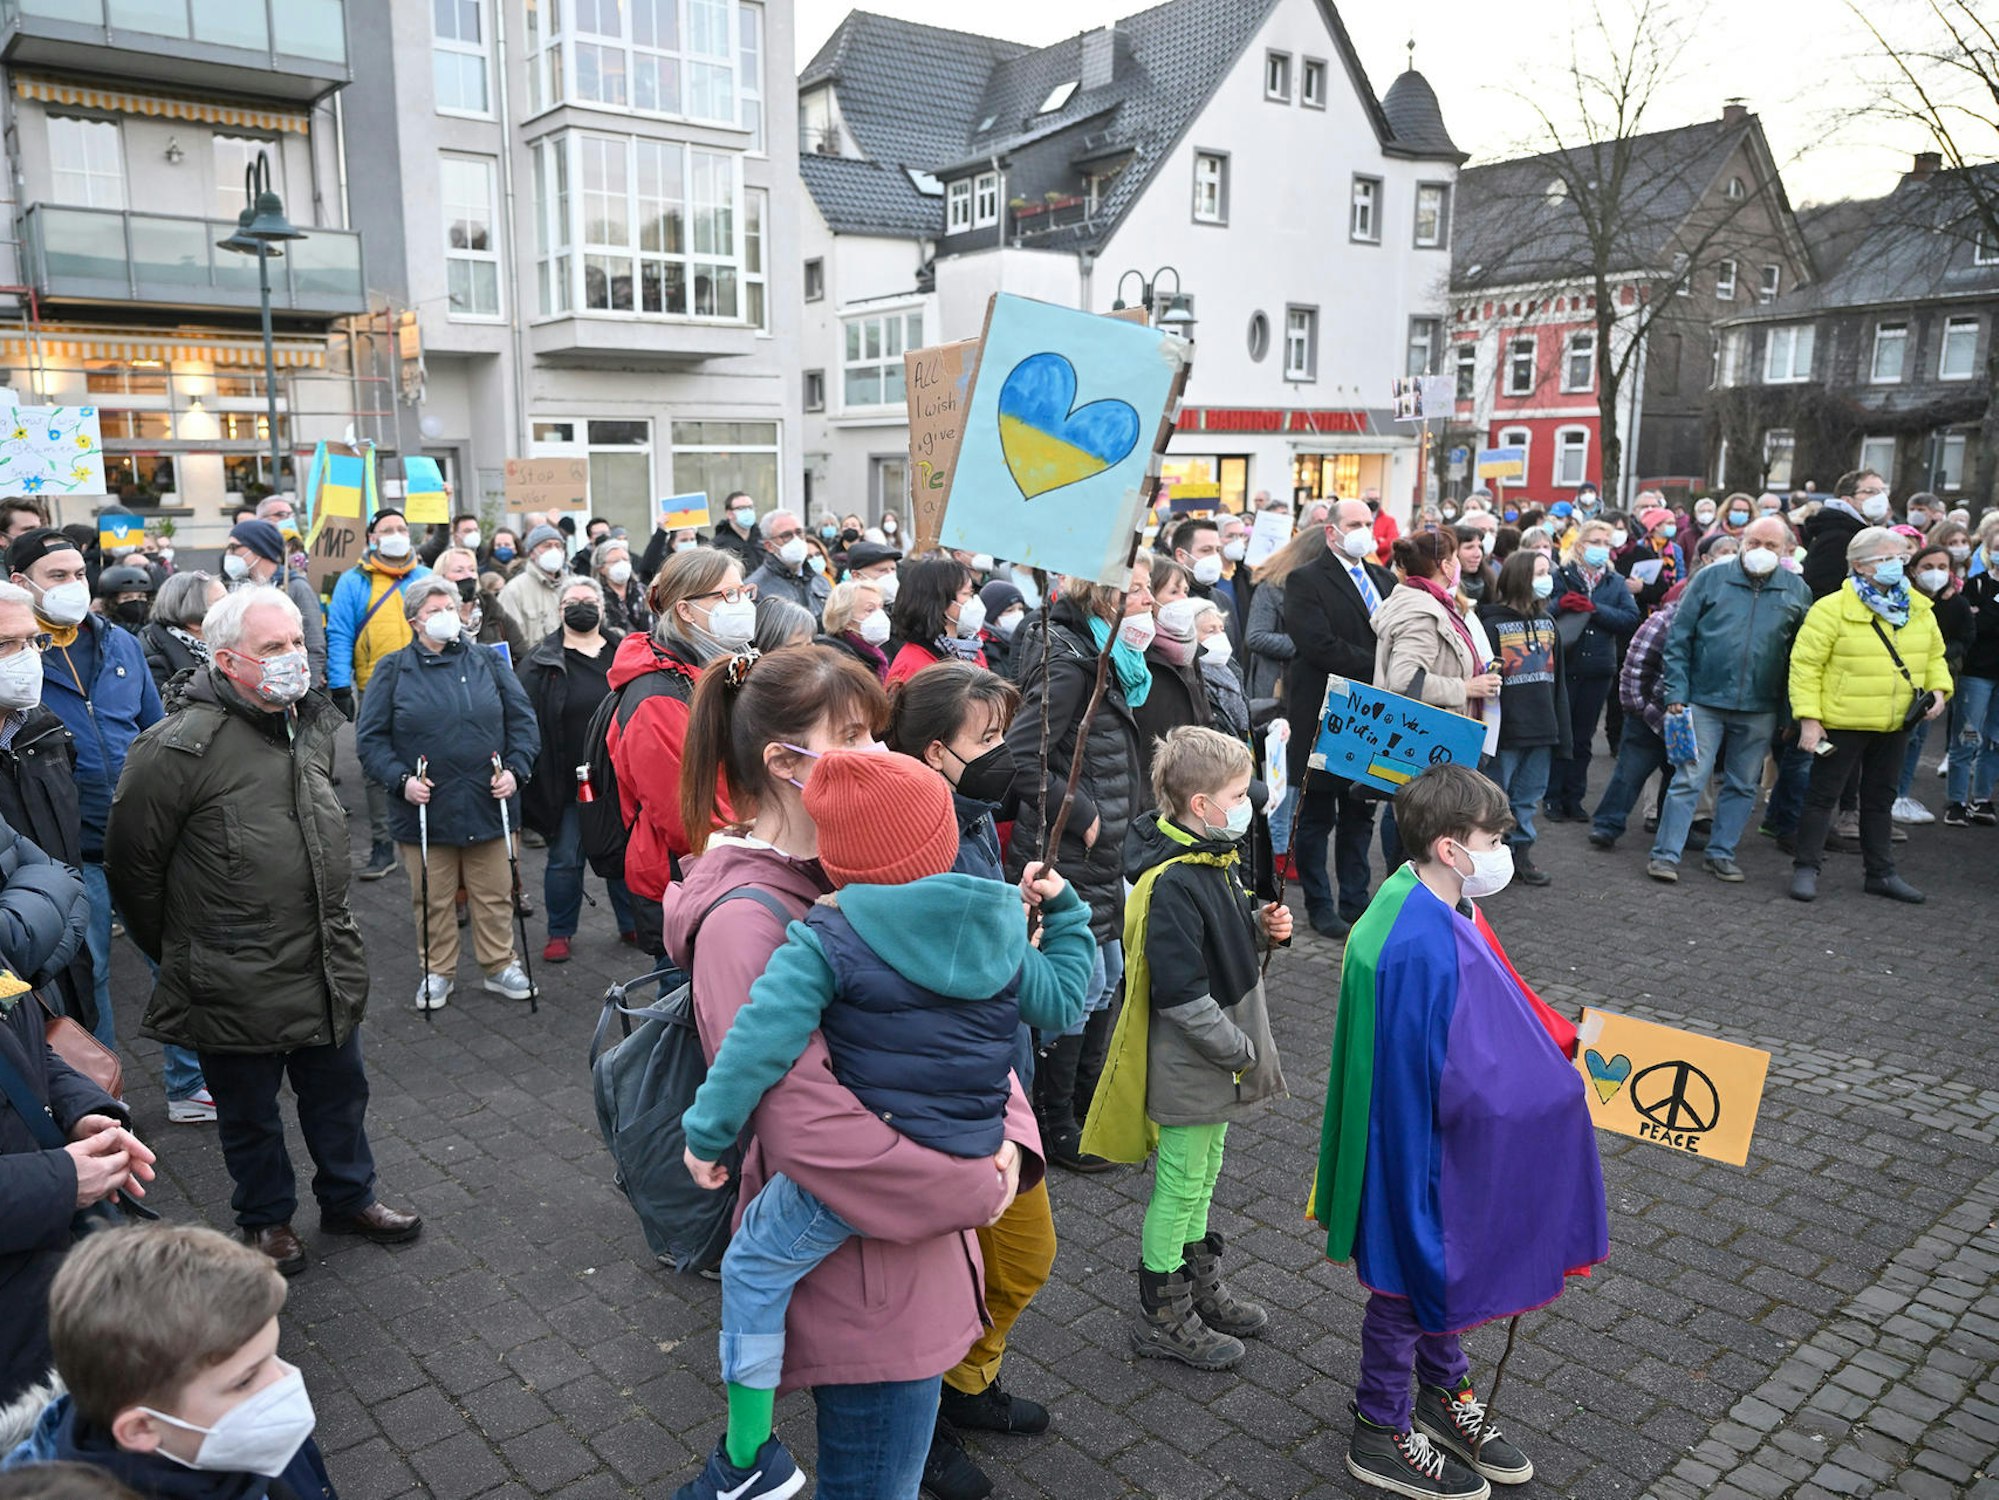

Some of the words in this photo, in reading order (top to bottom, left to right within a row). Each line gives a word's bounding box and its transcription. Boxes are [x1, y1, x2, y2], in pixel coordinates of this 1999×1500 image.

[916, 395, 921, 419] I
[925, 392, 957, 418] wish
[1205, 409, 1284, 431] BAHNHOF
[519, 466, 555, 485] Stop
[1348, 692, 1370, 715] No
[1345, 716, 1379, 746] Putin
[1639, 1121, 1700, 1153] PEACE
